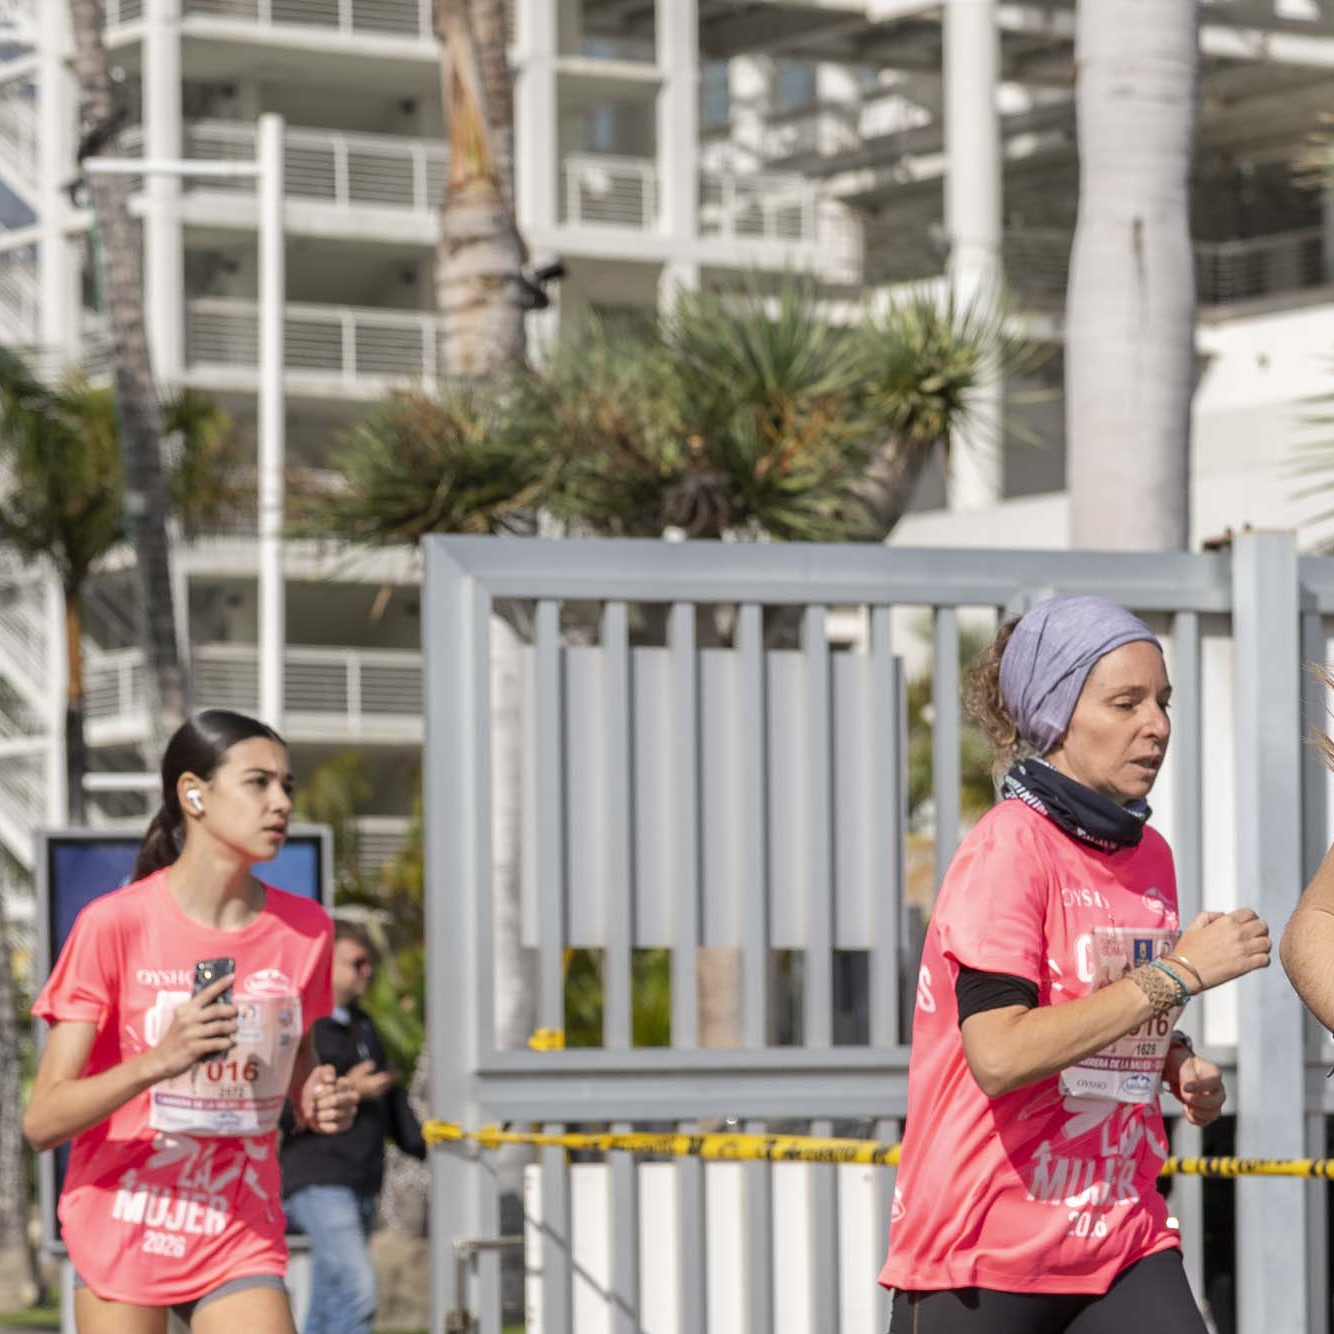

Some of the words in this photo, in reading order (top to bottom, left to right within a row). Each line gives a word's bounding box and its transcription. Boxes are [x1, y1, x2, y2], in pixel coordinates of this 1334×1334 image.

[206, 1060, 259, 1083] 016
[110, 1180, 229, 1237] MUJER
[142, 1228, 187, 1259] 2026
